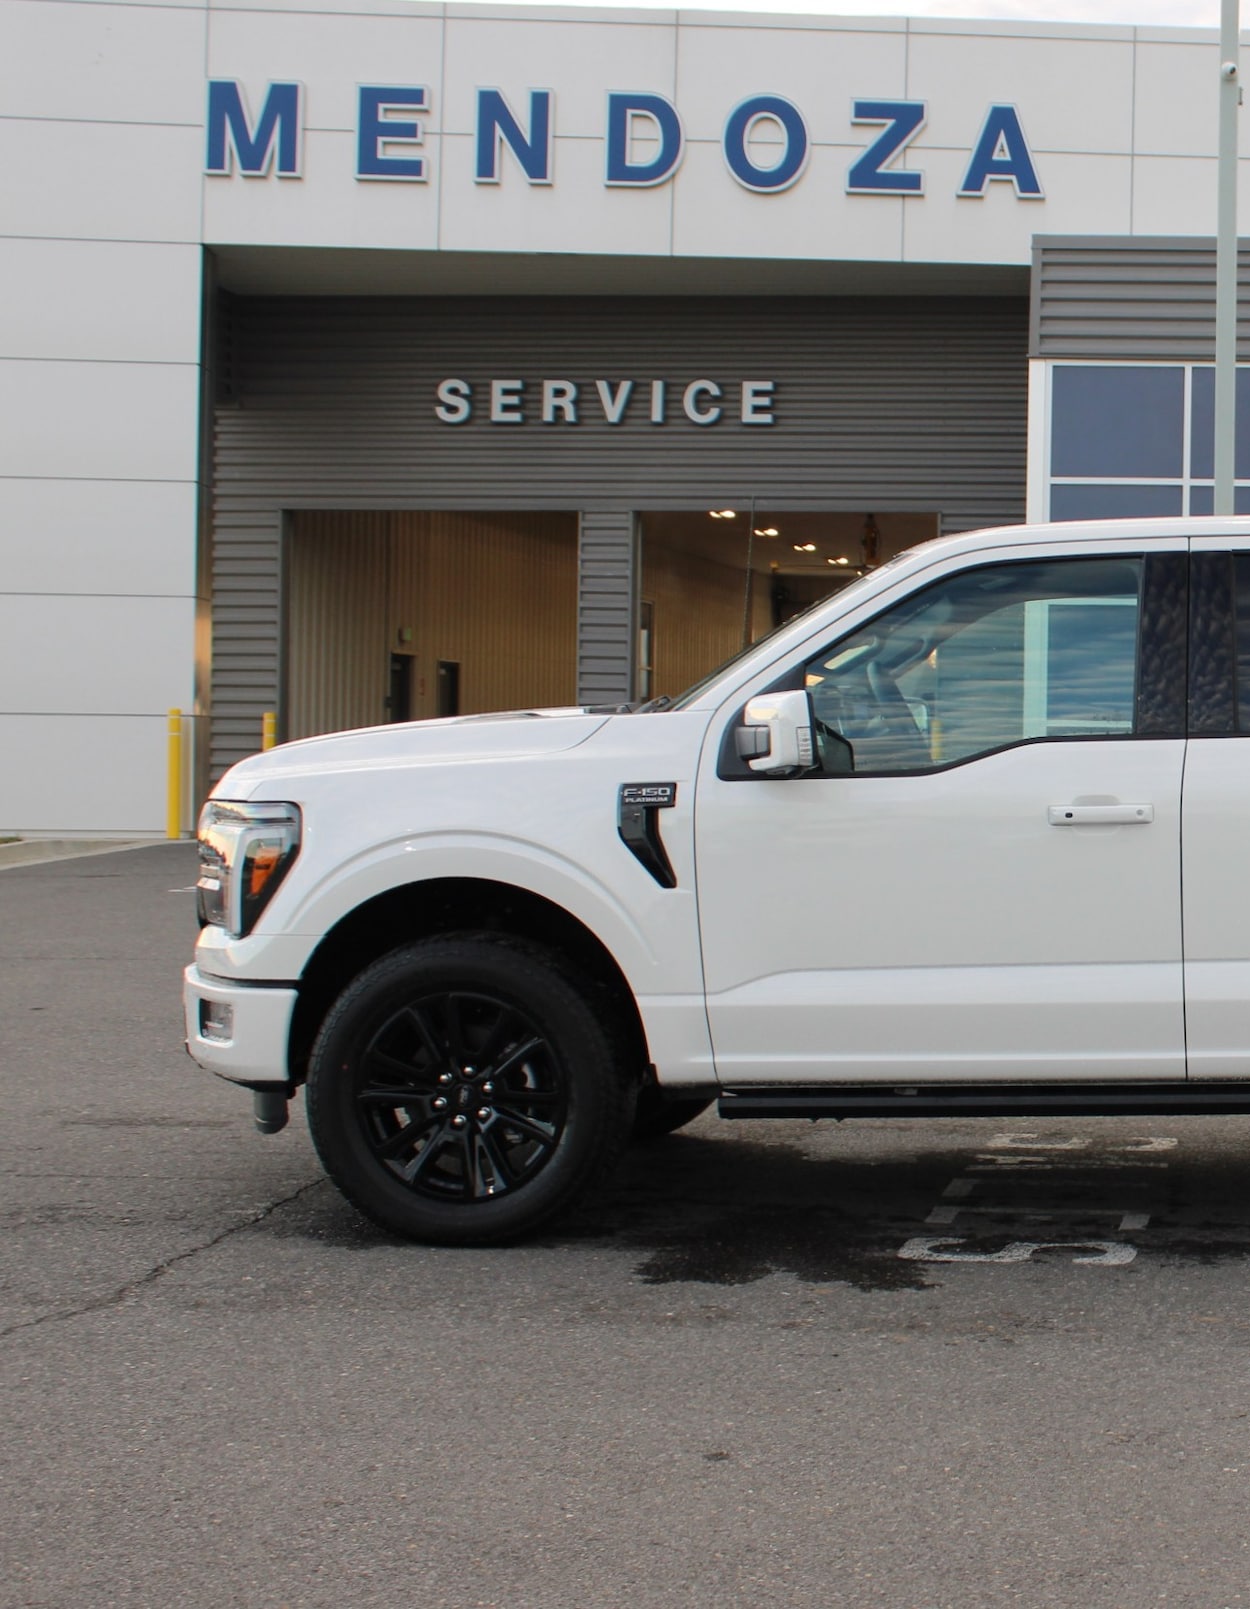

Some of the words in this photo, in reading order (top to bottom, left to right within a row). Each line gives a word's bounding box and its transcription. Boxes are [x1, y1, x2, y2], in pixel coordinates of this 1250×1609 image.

[205, 77, 1046, 200] MENDOZA
[435, 378, 777, 425] SERVICE
[623, 787, 671, 797] F-150
